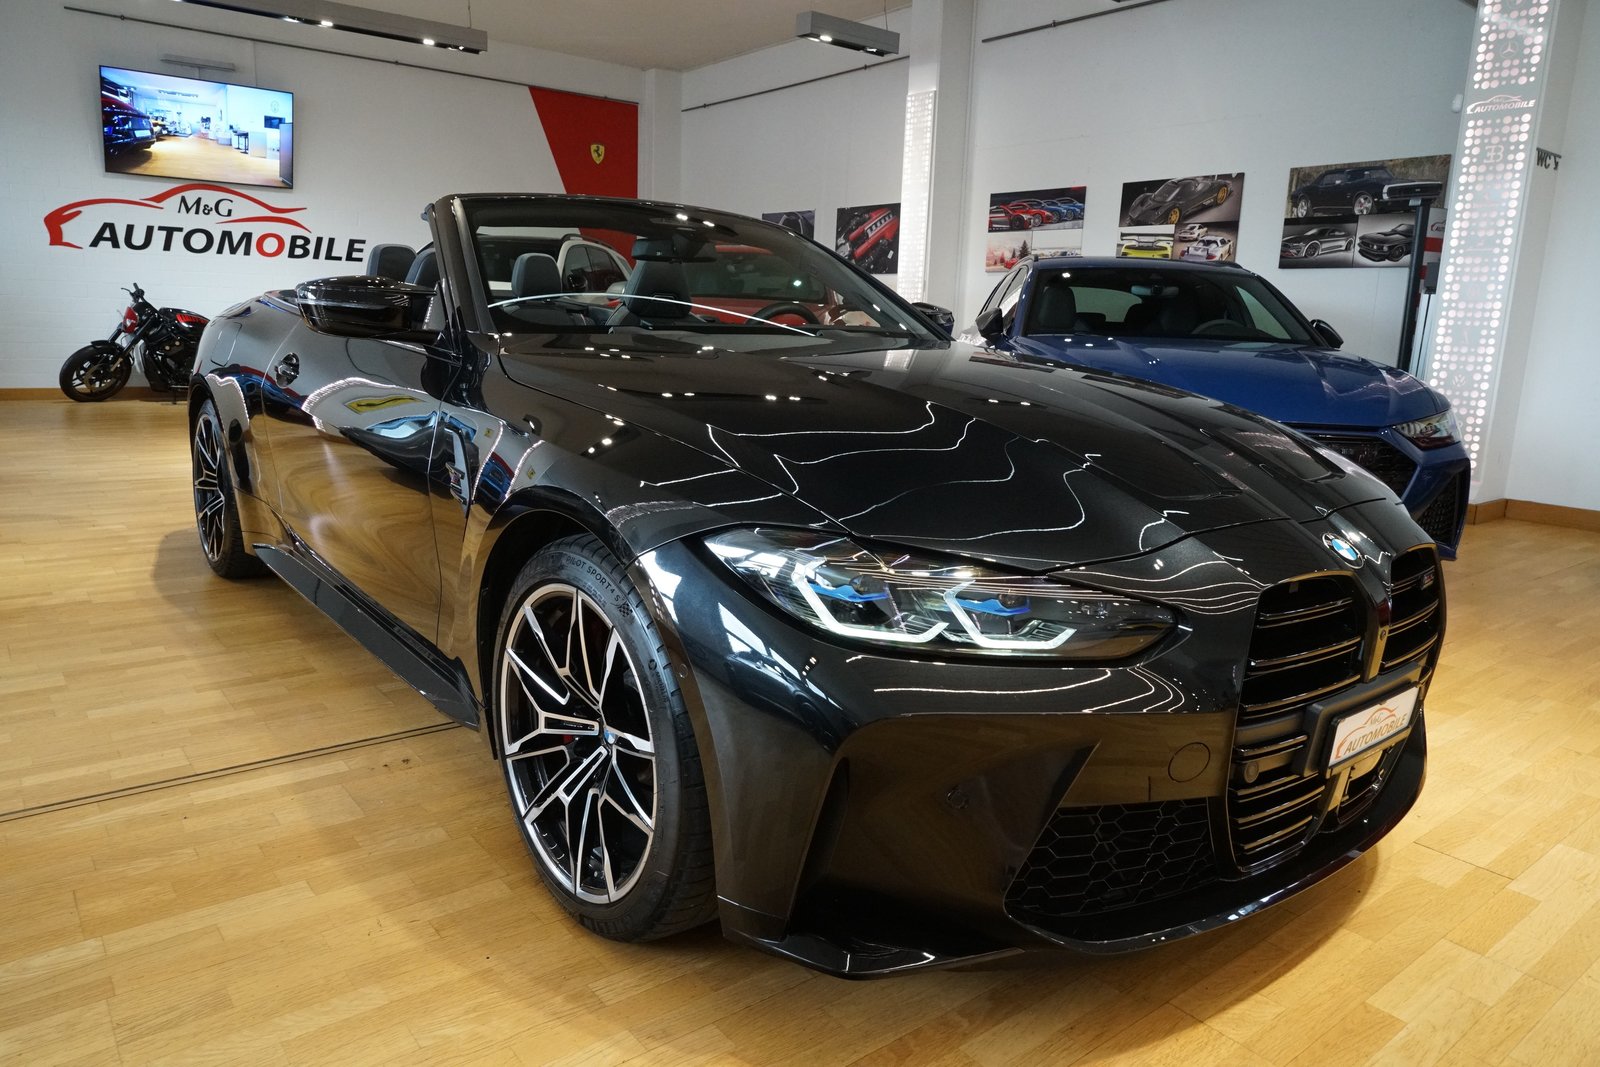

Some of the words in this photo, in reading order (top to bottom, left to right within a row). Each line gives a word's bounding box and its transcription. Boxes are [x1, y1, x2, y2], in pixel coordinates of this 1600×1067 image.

[1474, 99, 1536, 113] AUTOMOBILE
[178, 195, 233, 217] M&G
[89, 222, 367, 262] AUTOMOBILE
[566, 555, 587, 569] PILOT
[586, 566, 612, 590] SPORT
[1343, 713, 1407, 756] AUTOMOBILE
